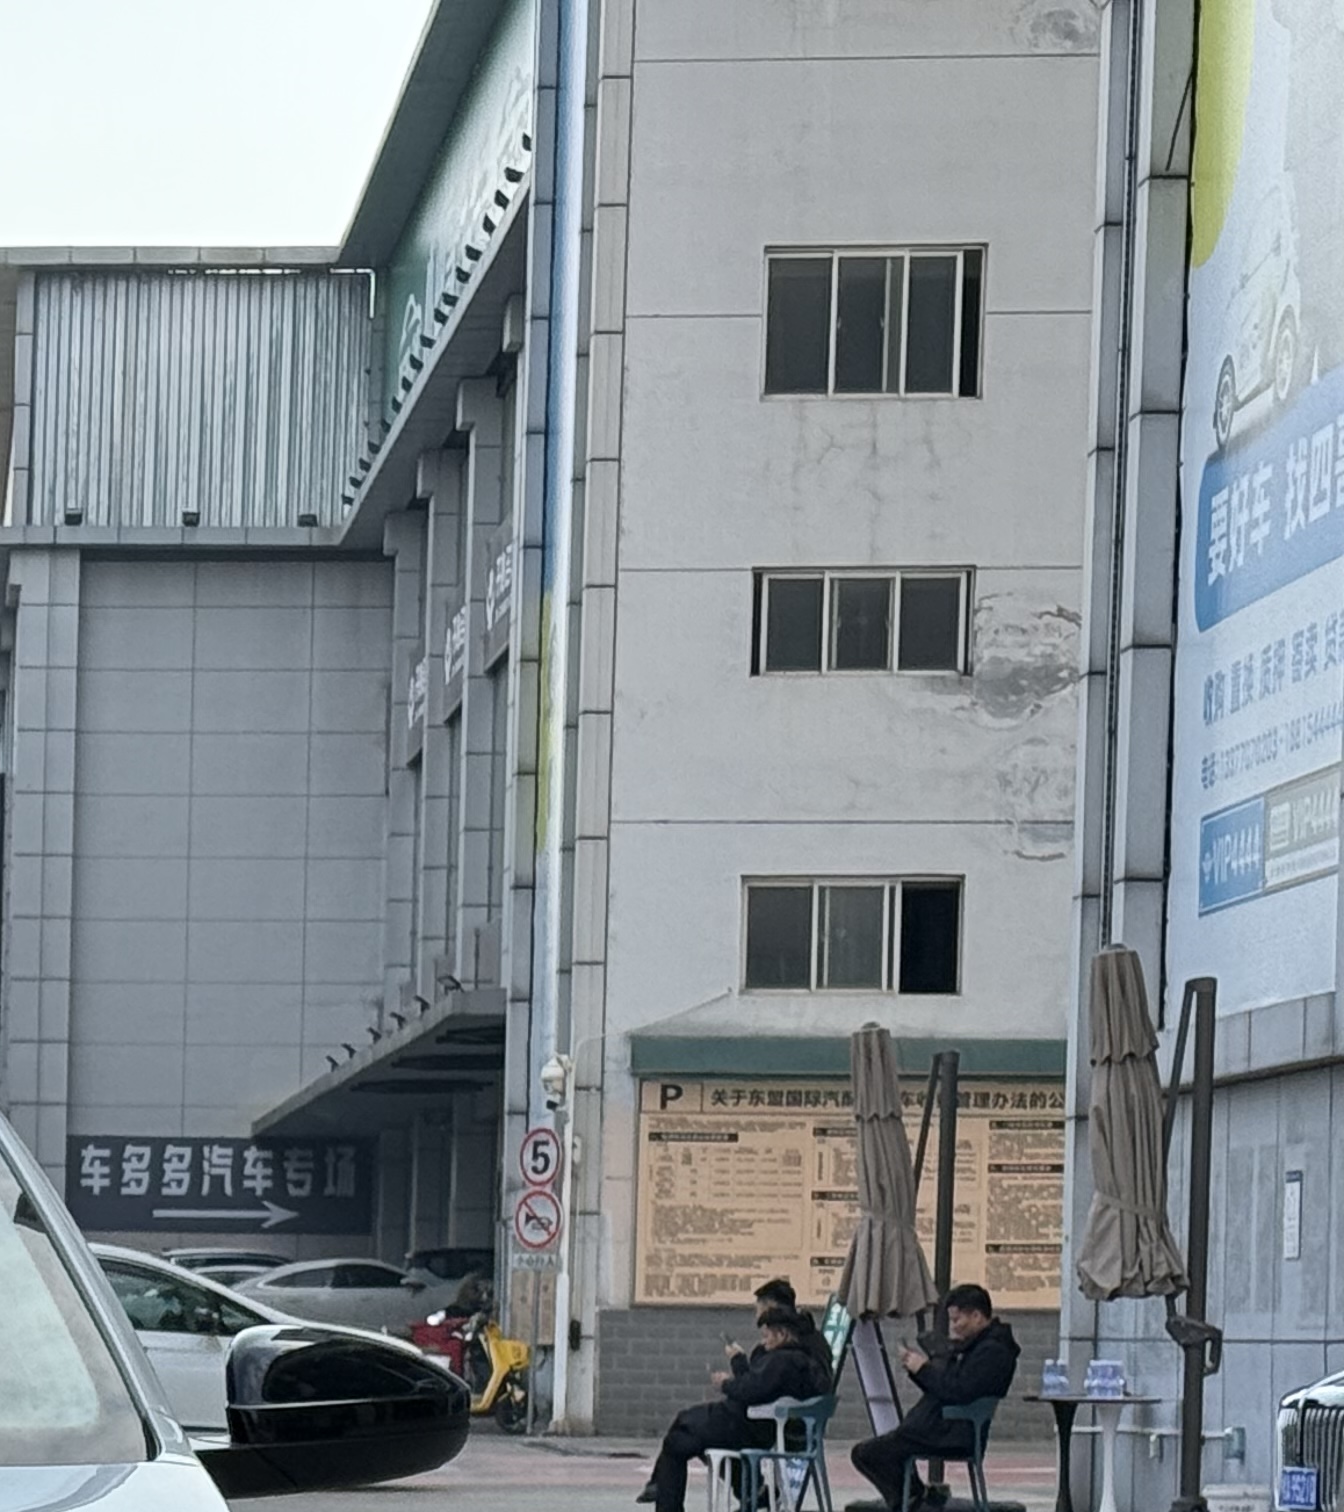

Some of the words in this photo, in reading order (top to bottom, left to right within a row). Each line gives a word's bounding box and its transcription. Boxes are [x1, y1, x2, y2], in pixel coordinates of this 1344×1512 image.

[1208, 460, 1273, 586] 要好车
[659, 1084, 684, 1110] P
[79, 1143, 357, 1199] 车多多汽车专场
[531, 1139, 553, 1175] 5
